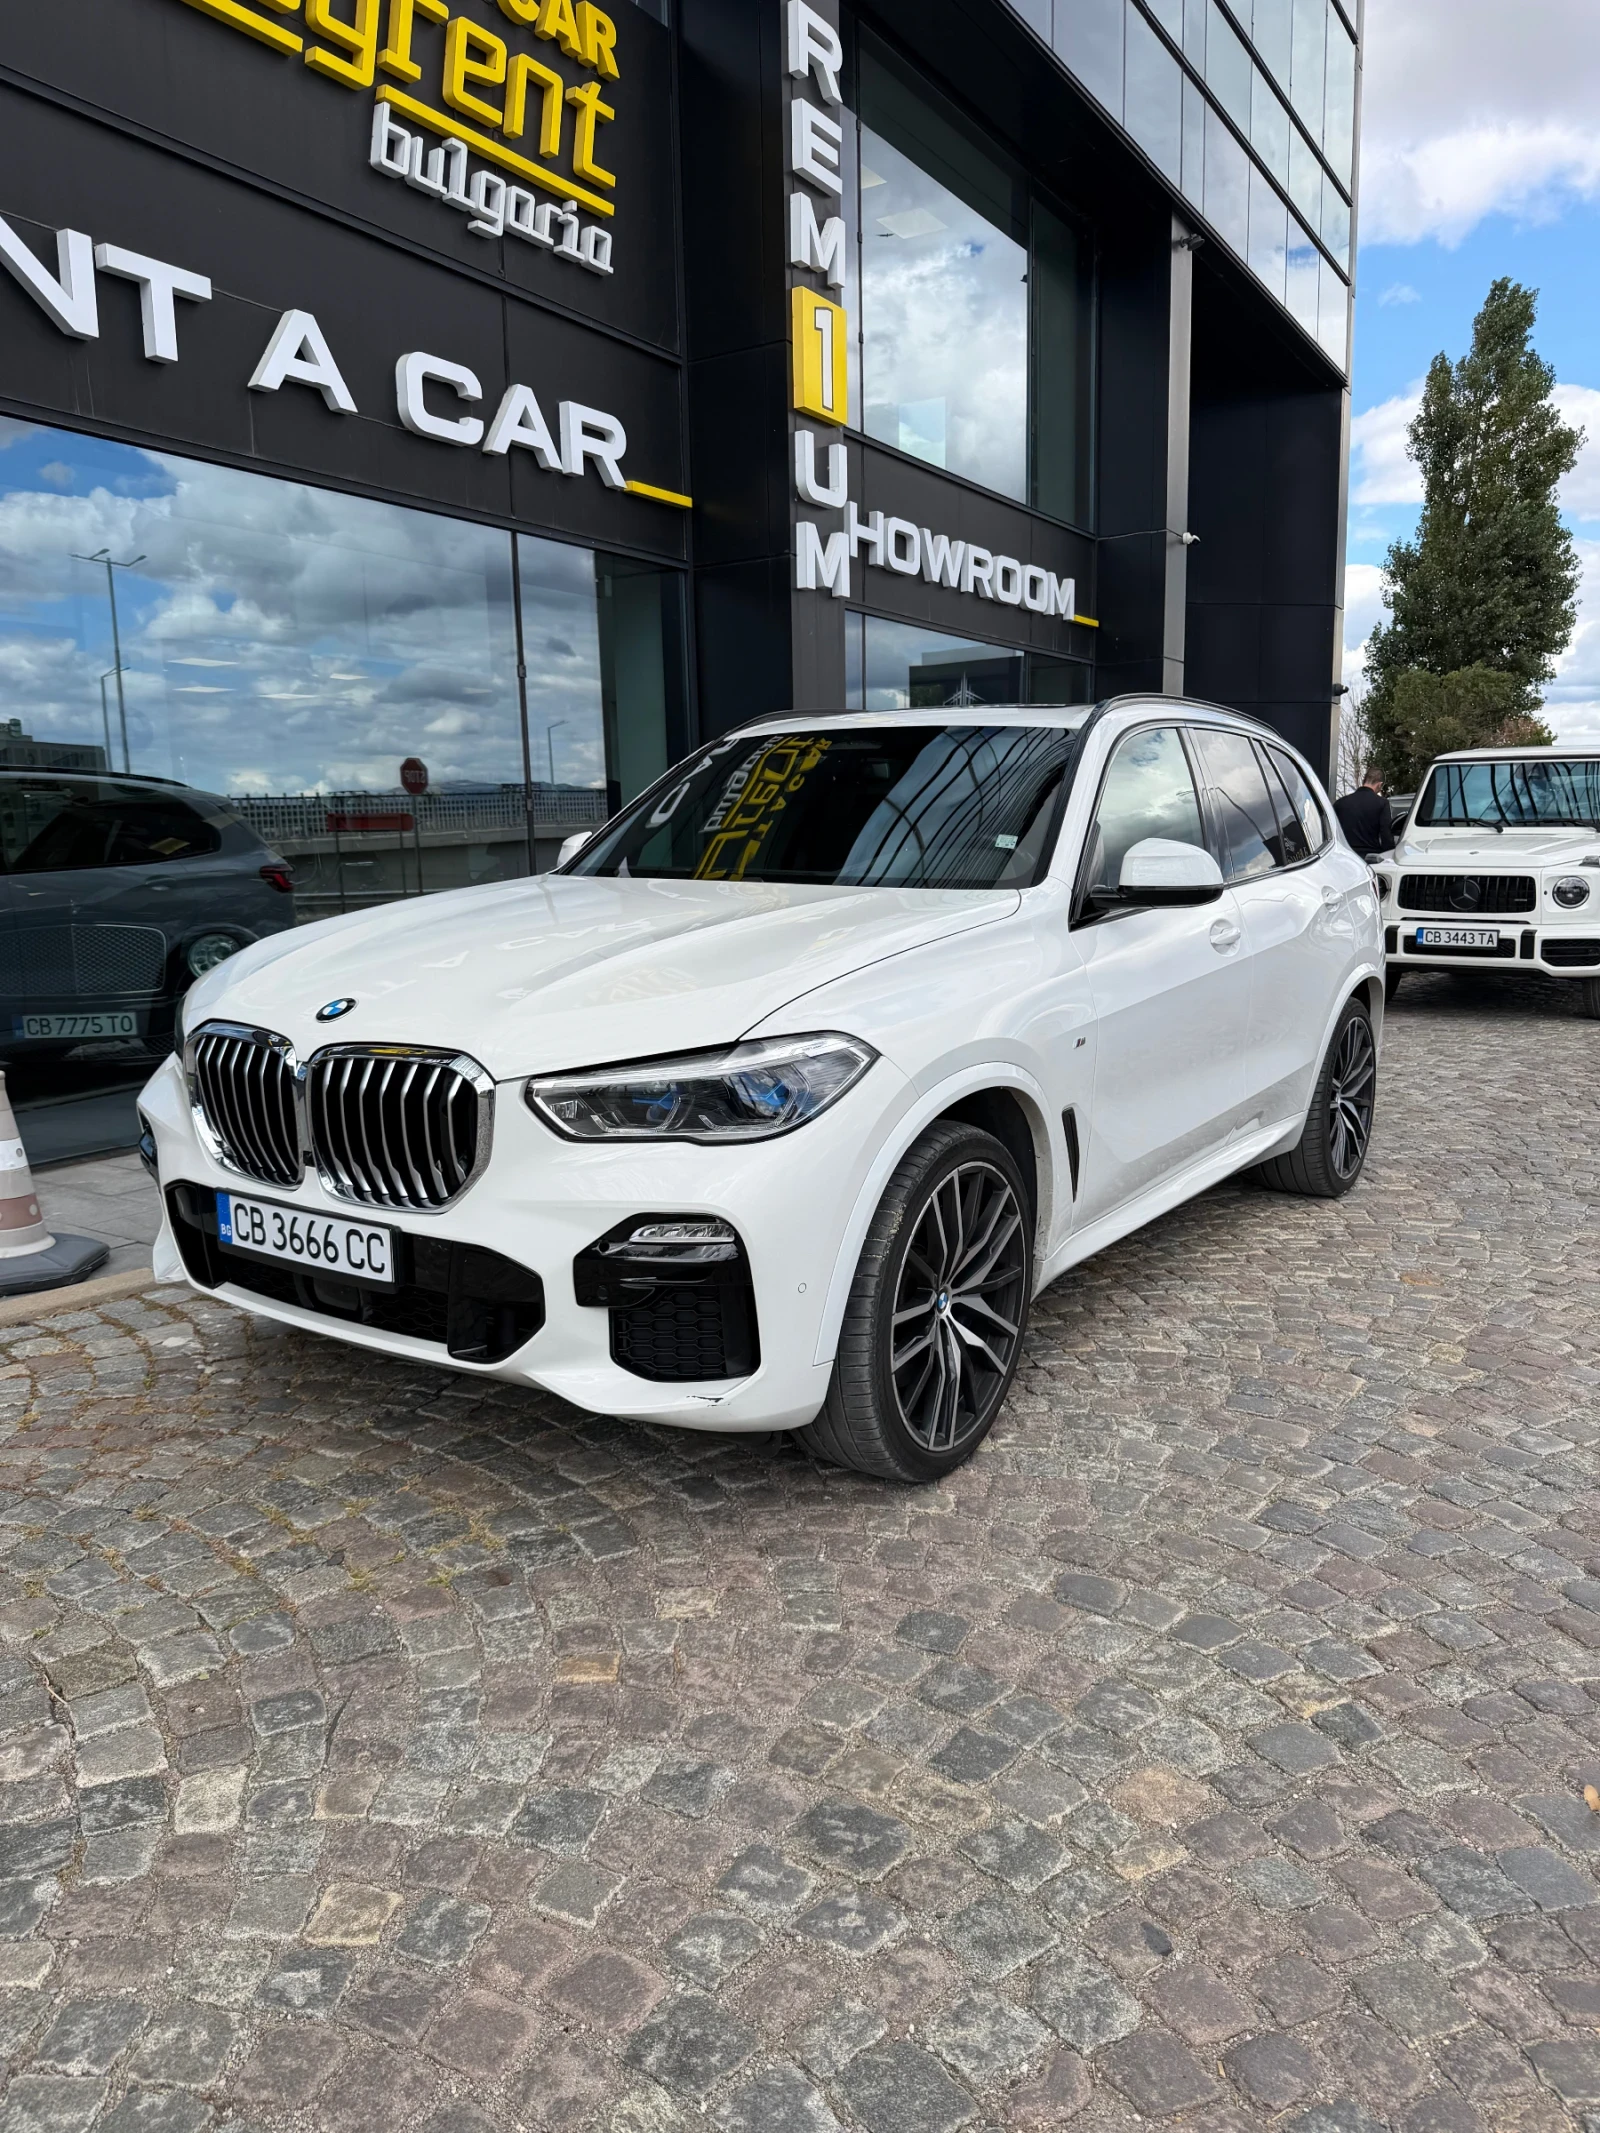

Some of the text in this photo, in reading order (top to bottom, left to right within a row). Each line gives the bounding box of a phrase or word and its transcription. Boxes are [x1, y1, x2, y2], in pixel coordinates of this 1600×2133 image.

[369, 101, 614, 276] bulgaria
[247, 308, 359, 414] A
[395, 351, 627, 490] CAR
[1425, 930, 1442, 944] CB
[1444, 931, 1476, 945] 3443
[1478, 932, 1495, 946] TA
[26, 1017, 52, 1036] CB
[55, 1016, 104, 1035] 7775
[234, 1202, 386, 1274] CB 3666 CC
